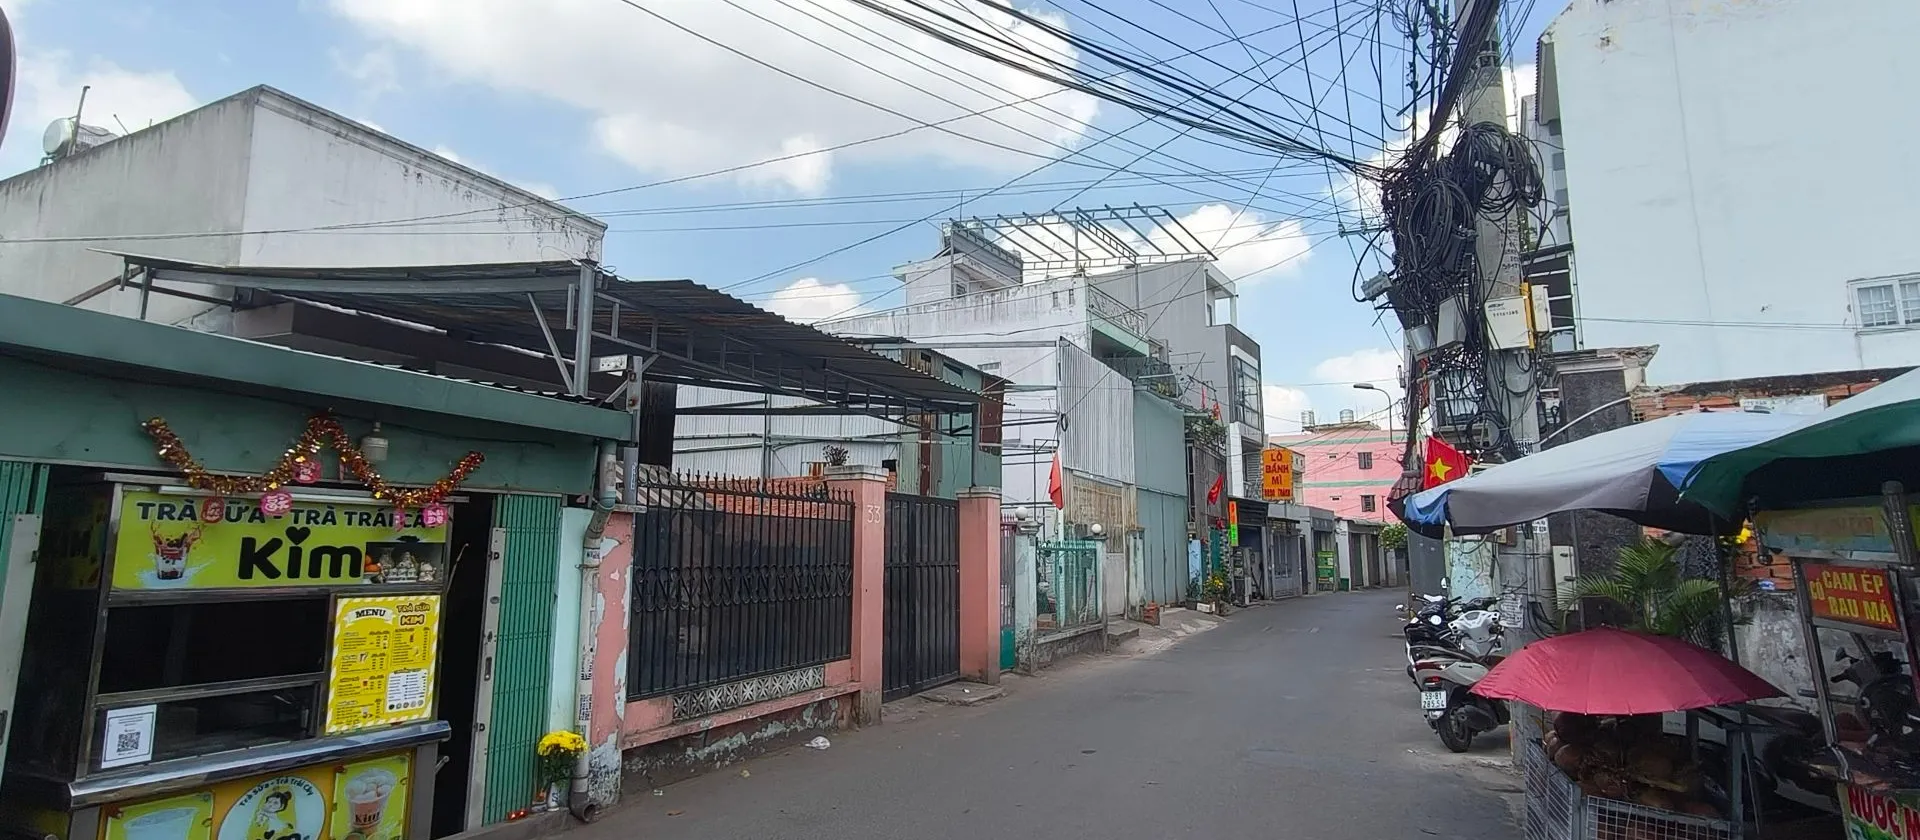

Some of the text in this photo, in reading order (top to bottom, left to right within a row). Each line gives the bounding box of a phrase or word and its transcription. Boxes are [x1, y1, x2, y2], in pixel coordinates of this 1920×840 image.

[1270, 451, 1283, 462] LÒ
[1265, 462, 1289, 474] BÁNH
[1271, 474, 1282, 485] MÌ
[136, 499, 198, 522] TRÀ
[213, 497, 265, 524] ỮA
[289, 503, 338, 526] TRÀ
[867, 504, 881, 523] 33
[237, 527, 363, 580] Kim
[1822, 570, 1883, 595] CAM ÉP
[355, 608, 386, 619] MENU
[1863, 599, 1893, 624] MÁ
